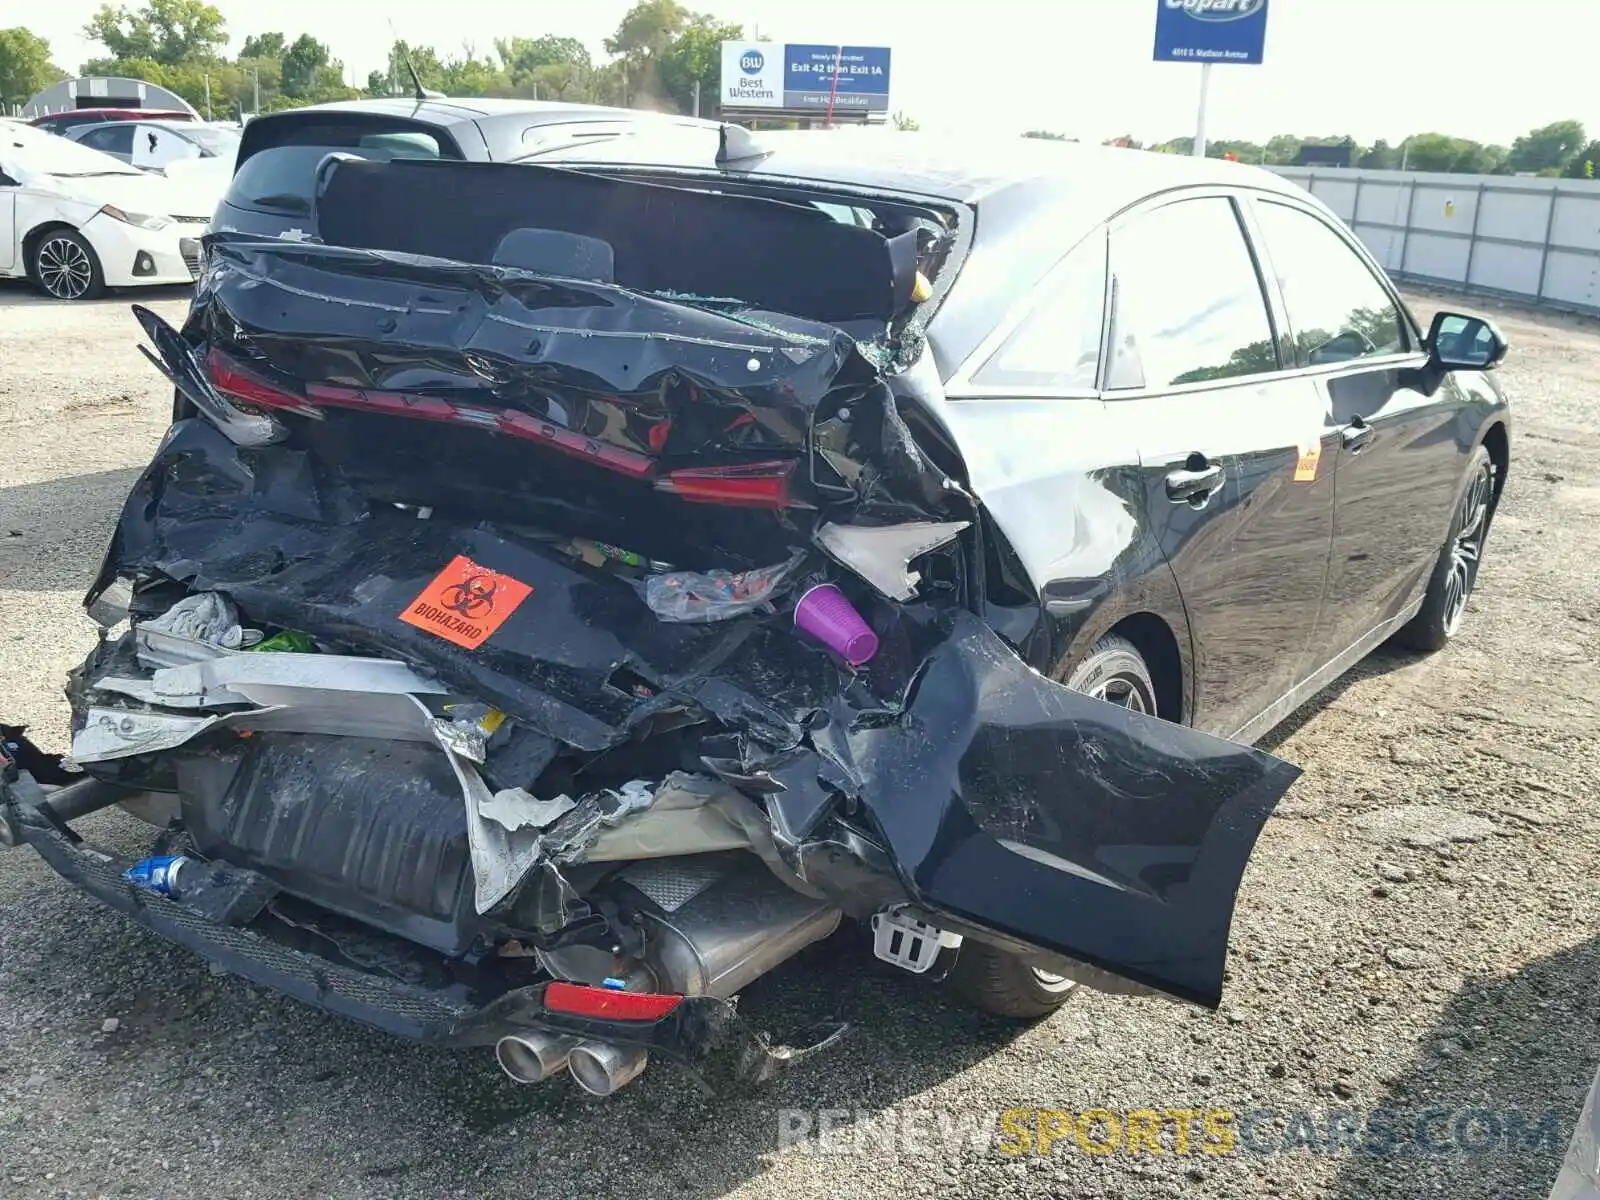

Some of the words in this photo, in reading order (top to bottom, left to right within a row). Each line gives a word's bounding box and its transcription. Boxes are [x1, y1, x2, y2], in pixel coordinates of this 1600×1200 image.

[832, 54, 865, 62] Rnovated
[1225, 49, 1248, 58] Avenue
[742, 56, 761, 69] BW
[791, 63, 810, 72] Exit
[812, 63, 824, 73] 42
[826, 63, 848, 73] then
[850, 65, 868, 74] Exit
[871, 65, 883, 75] 1A
[740, 77, 763, 88] Best
[729, 87, 774, 99] Western
[413, 602, 482, 640] BIOHAZARD
